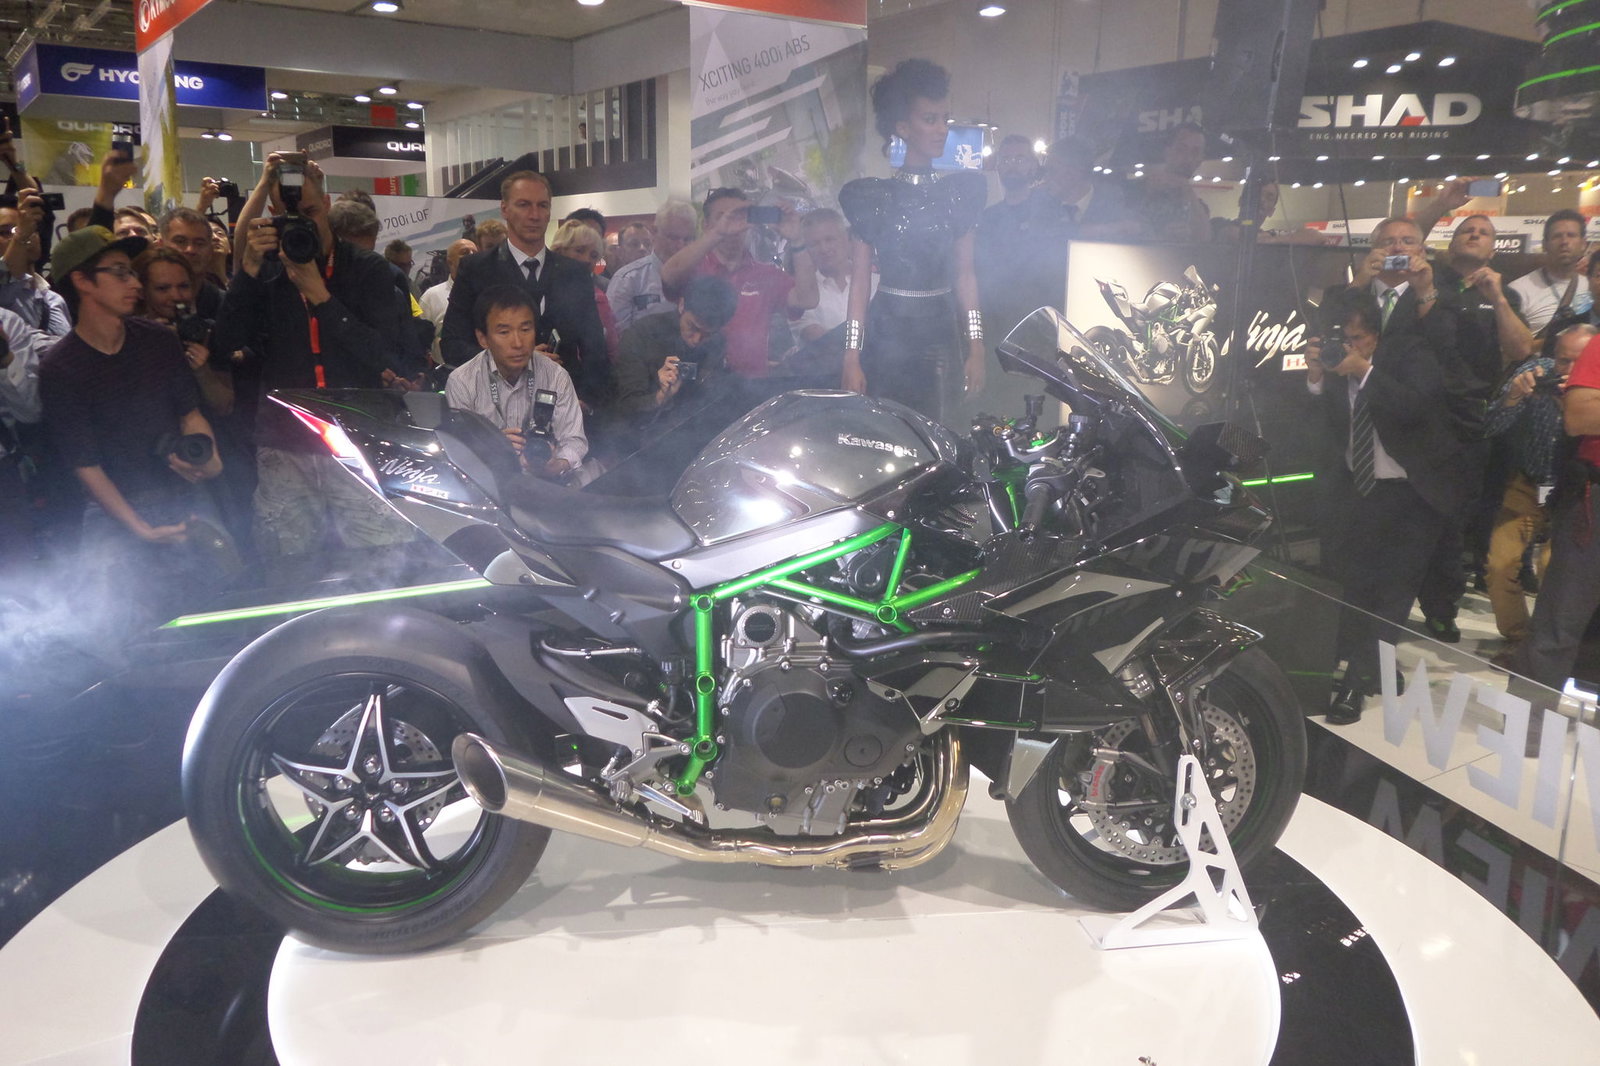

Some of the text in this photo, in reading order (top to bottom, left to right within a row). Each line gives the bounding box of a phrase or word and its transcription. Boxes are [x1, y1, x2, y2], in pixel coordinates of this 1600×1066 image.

[698, 57, 752, 92] XCITING
[754, 46, 784, 69] 400i
[785, 34, 811, 57] ABS
[98, 68, 204, 90] HYONG
[1137, 105, 1204, 133] SHA
[1297, 93, 1482, 128] SHAD
[1309, 130, 1450, 140] ENGNEERED FOR RIDING
[386, 141, 426, 152] QUA
[383, 208, 430, 230] 700i LOF
[1494, 239, 1521, 249] HAD
[491, 382, 499, 403] PRESS
[838, 433, 918, 458] Kawasaki
[380, 458, 441, 485] Ninja
